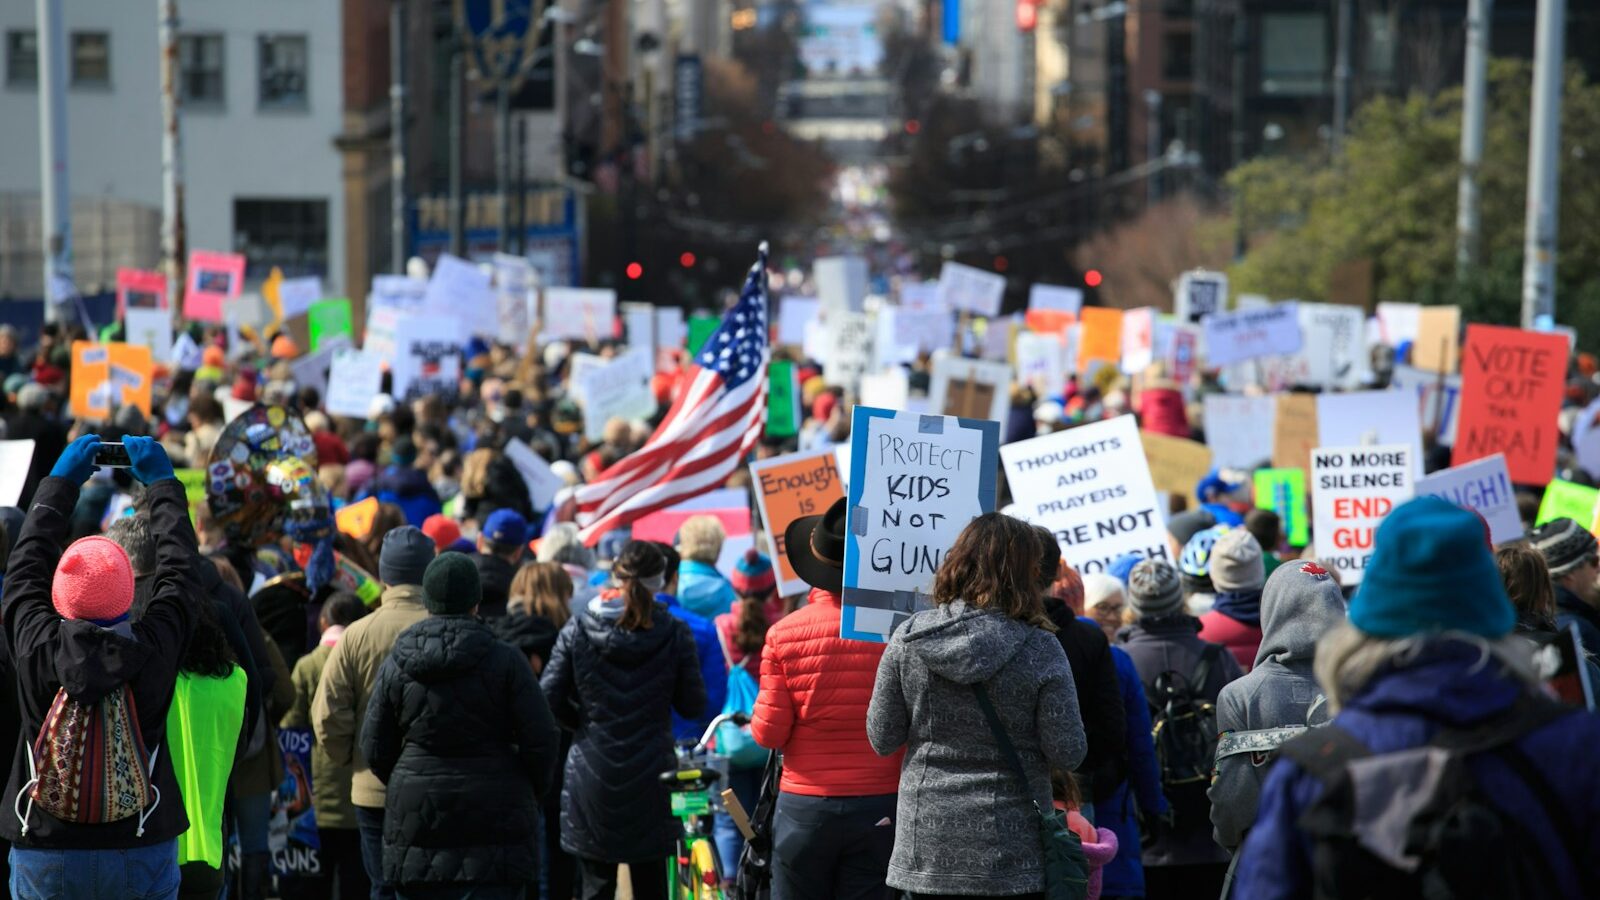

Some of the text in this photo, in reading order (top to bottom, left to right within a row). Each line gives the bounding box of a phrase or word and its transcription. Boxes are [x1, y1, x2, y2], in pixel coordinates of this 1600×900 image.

[1471, 344, 1552, 377] VOTE
[1485, 375, 1543, 402] OUT
[879, 434, 974, 471] PROTECT
[1015, 437, 1121, 472] THOUGHTS
[1466, 426, 1541, 462] NRA!
[1316, 452, 1406, 468] NO MORE
[760, 455, 838, 495] Enough
[887, 474, 951, 505] KIDS
[1057, 468, 1098, 487] AND
[1320, 473, 1404, 489] SILENCE
[796, 491, 815, 514] is
[1037, 485, 1127, 516] PRAYERS
[1333, 497, 1393, 519] END
[882, 508, 946, 530] NOT
[1052, 509, 1154, 546] RE NOT
[1333, 527, 1377, 549] GU
[871, 538, 940, 575] GUN
[272, 848, 320, 874] GUNS
